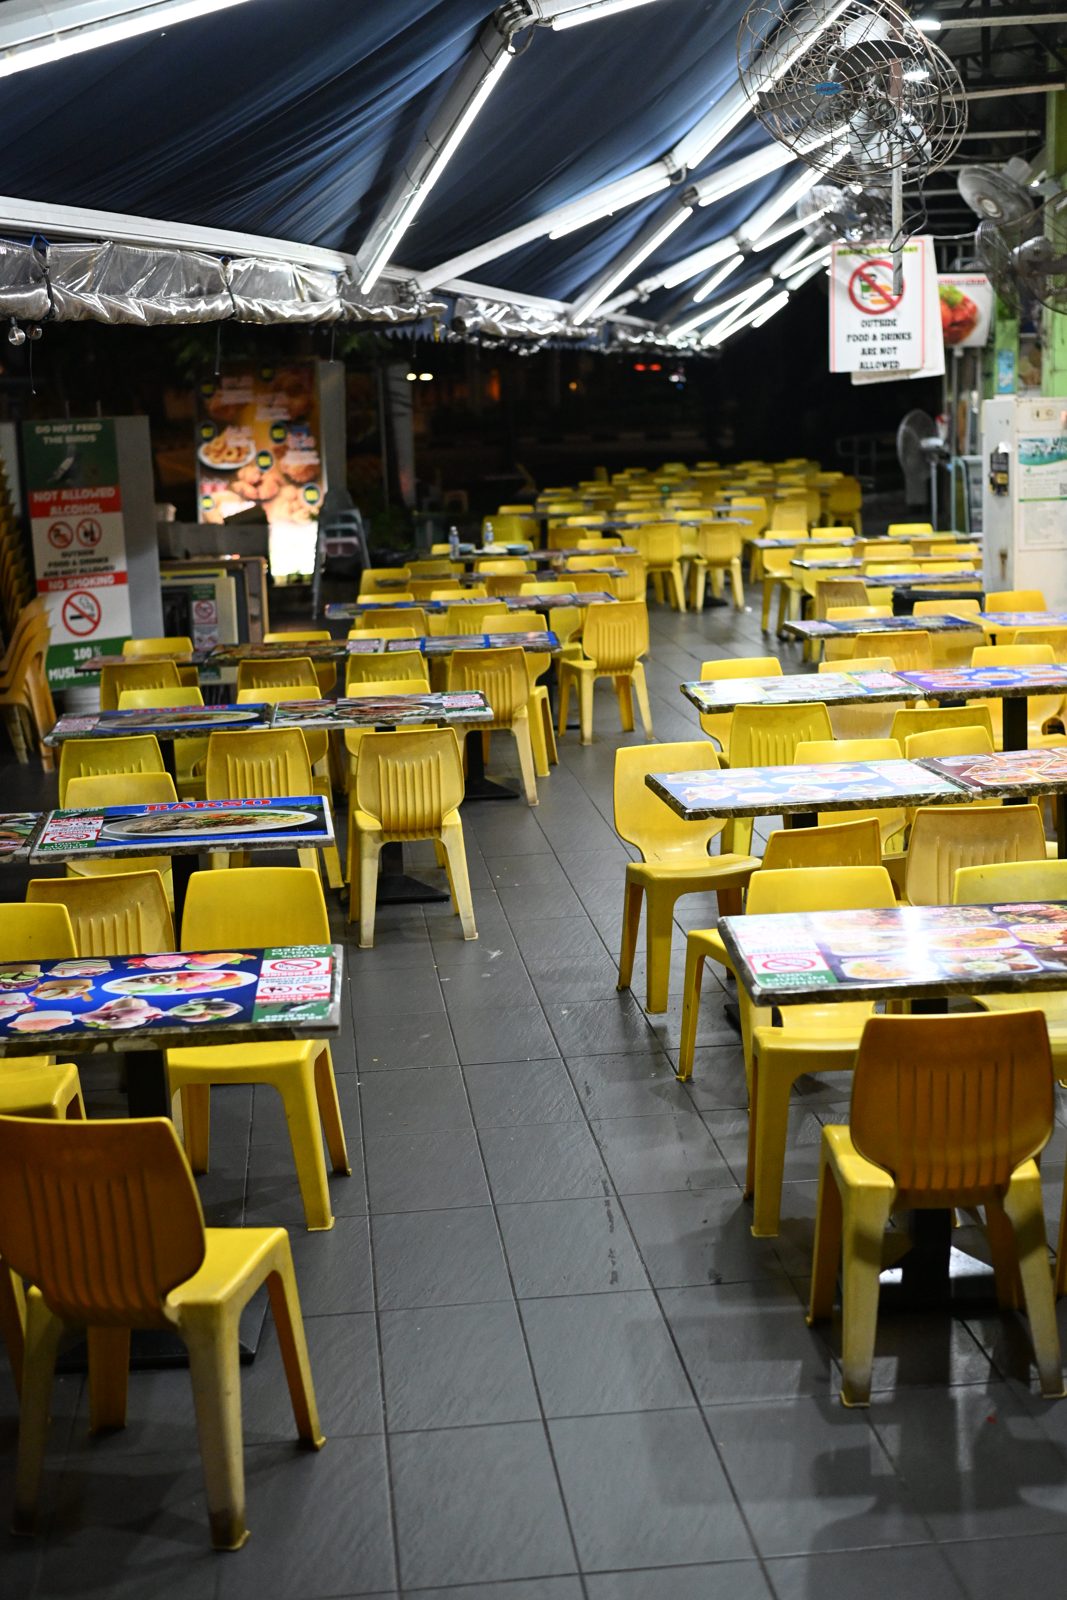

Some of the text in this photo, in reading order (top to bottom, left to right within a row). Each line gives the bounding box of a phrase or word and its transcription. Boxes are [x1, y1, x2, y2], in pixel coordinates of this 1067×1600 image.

[860, 318, 898, 328] OUTSIDE
[846, 332, 912, 343] FOOD & DRINKS
[860, 346, 898, 356] ARE NOT
[859, 360, 900, 370] ALLOWED
[35, 422, 102, 434] DO NOT FEED
[43, 435, 63, 445] THE
[33, 486, 116, 503] NOT ALLOWED
[49, 503, 103, 516] ALCOHOL
[48, 574, 115, 590] NO SMOKING
[144, 799, 272, 813] BAKSO
